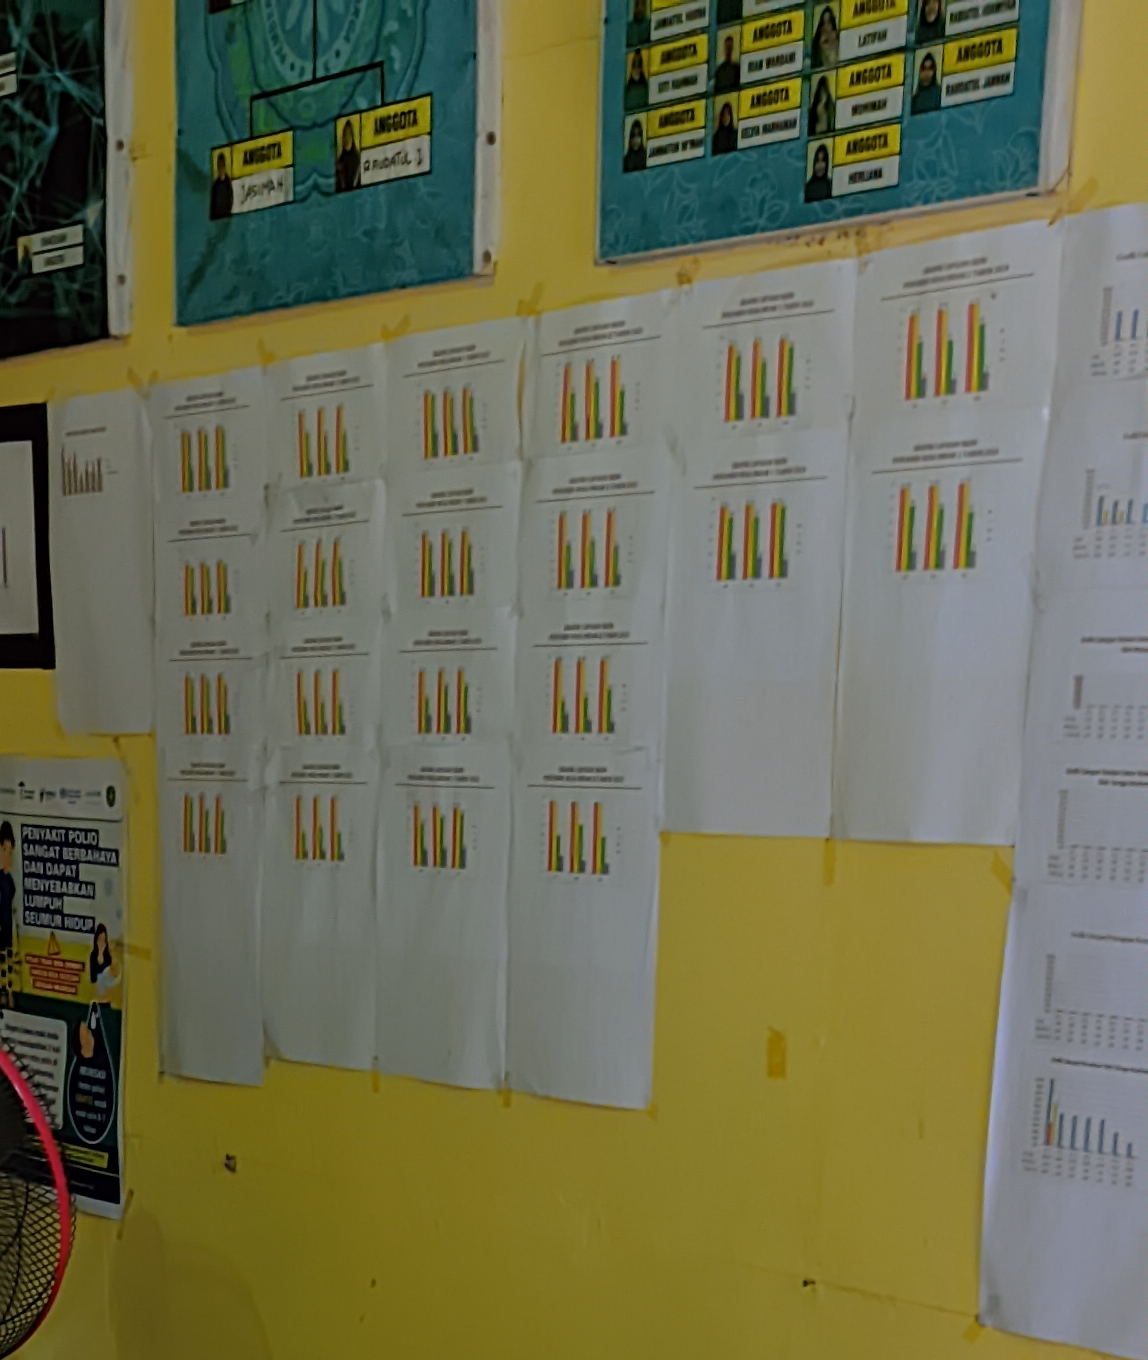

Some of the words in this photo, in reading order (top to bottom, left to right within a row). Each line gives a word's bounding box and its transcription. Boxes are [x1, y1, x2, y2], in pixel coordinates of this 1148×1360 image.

[752, 20, 793, 43] ANGGOTA
[660, 44, 698, 65] ANGGOTA
[956, 38, 1003, 63] ANGGOTA
[849, 63, 892, 88] ANGGOTA
[749, 87, 790, 109] ANGGOTA
[373, 110, 419, 134] ANGGOTA
[658, 108, 695, 129] ANGGOTA
[242, 142, 282, 166] ANGGOTA
[845, 133, 888, 156] ANGGOTA
[21, 826, 66, 842] PENYAKIT
[68, 829, 98, 846] POLIO
[22, 843, 60, 860] SANGAT
[62, 847, 117, 865] BERBAHAYA
[23, 860, 44, 875] DAN
[45, 862, 77, 878] DAPAT
[24, 877, 94, 897] MENYEBABKAN
[24, 894, 63, 910] LUMPUH
[24, 911, 62, 927] SEUMUR
[64, 916, 94, 931] HIDUP
